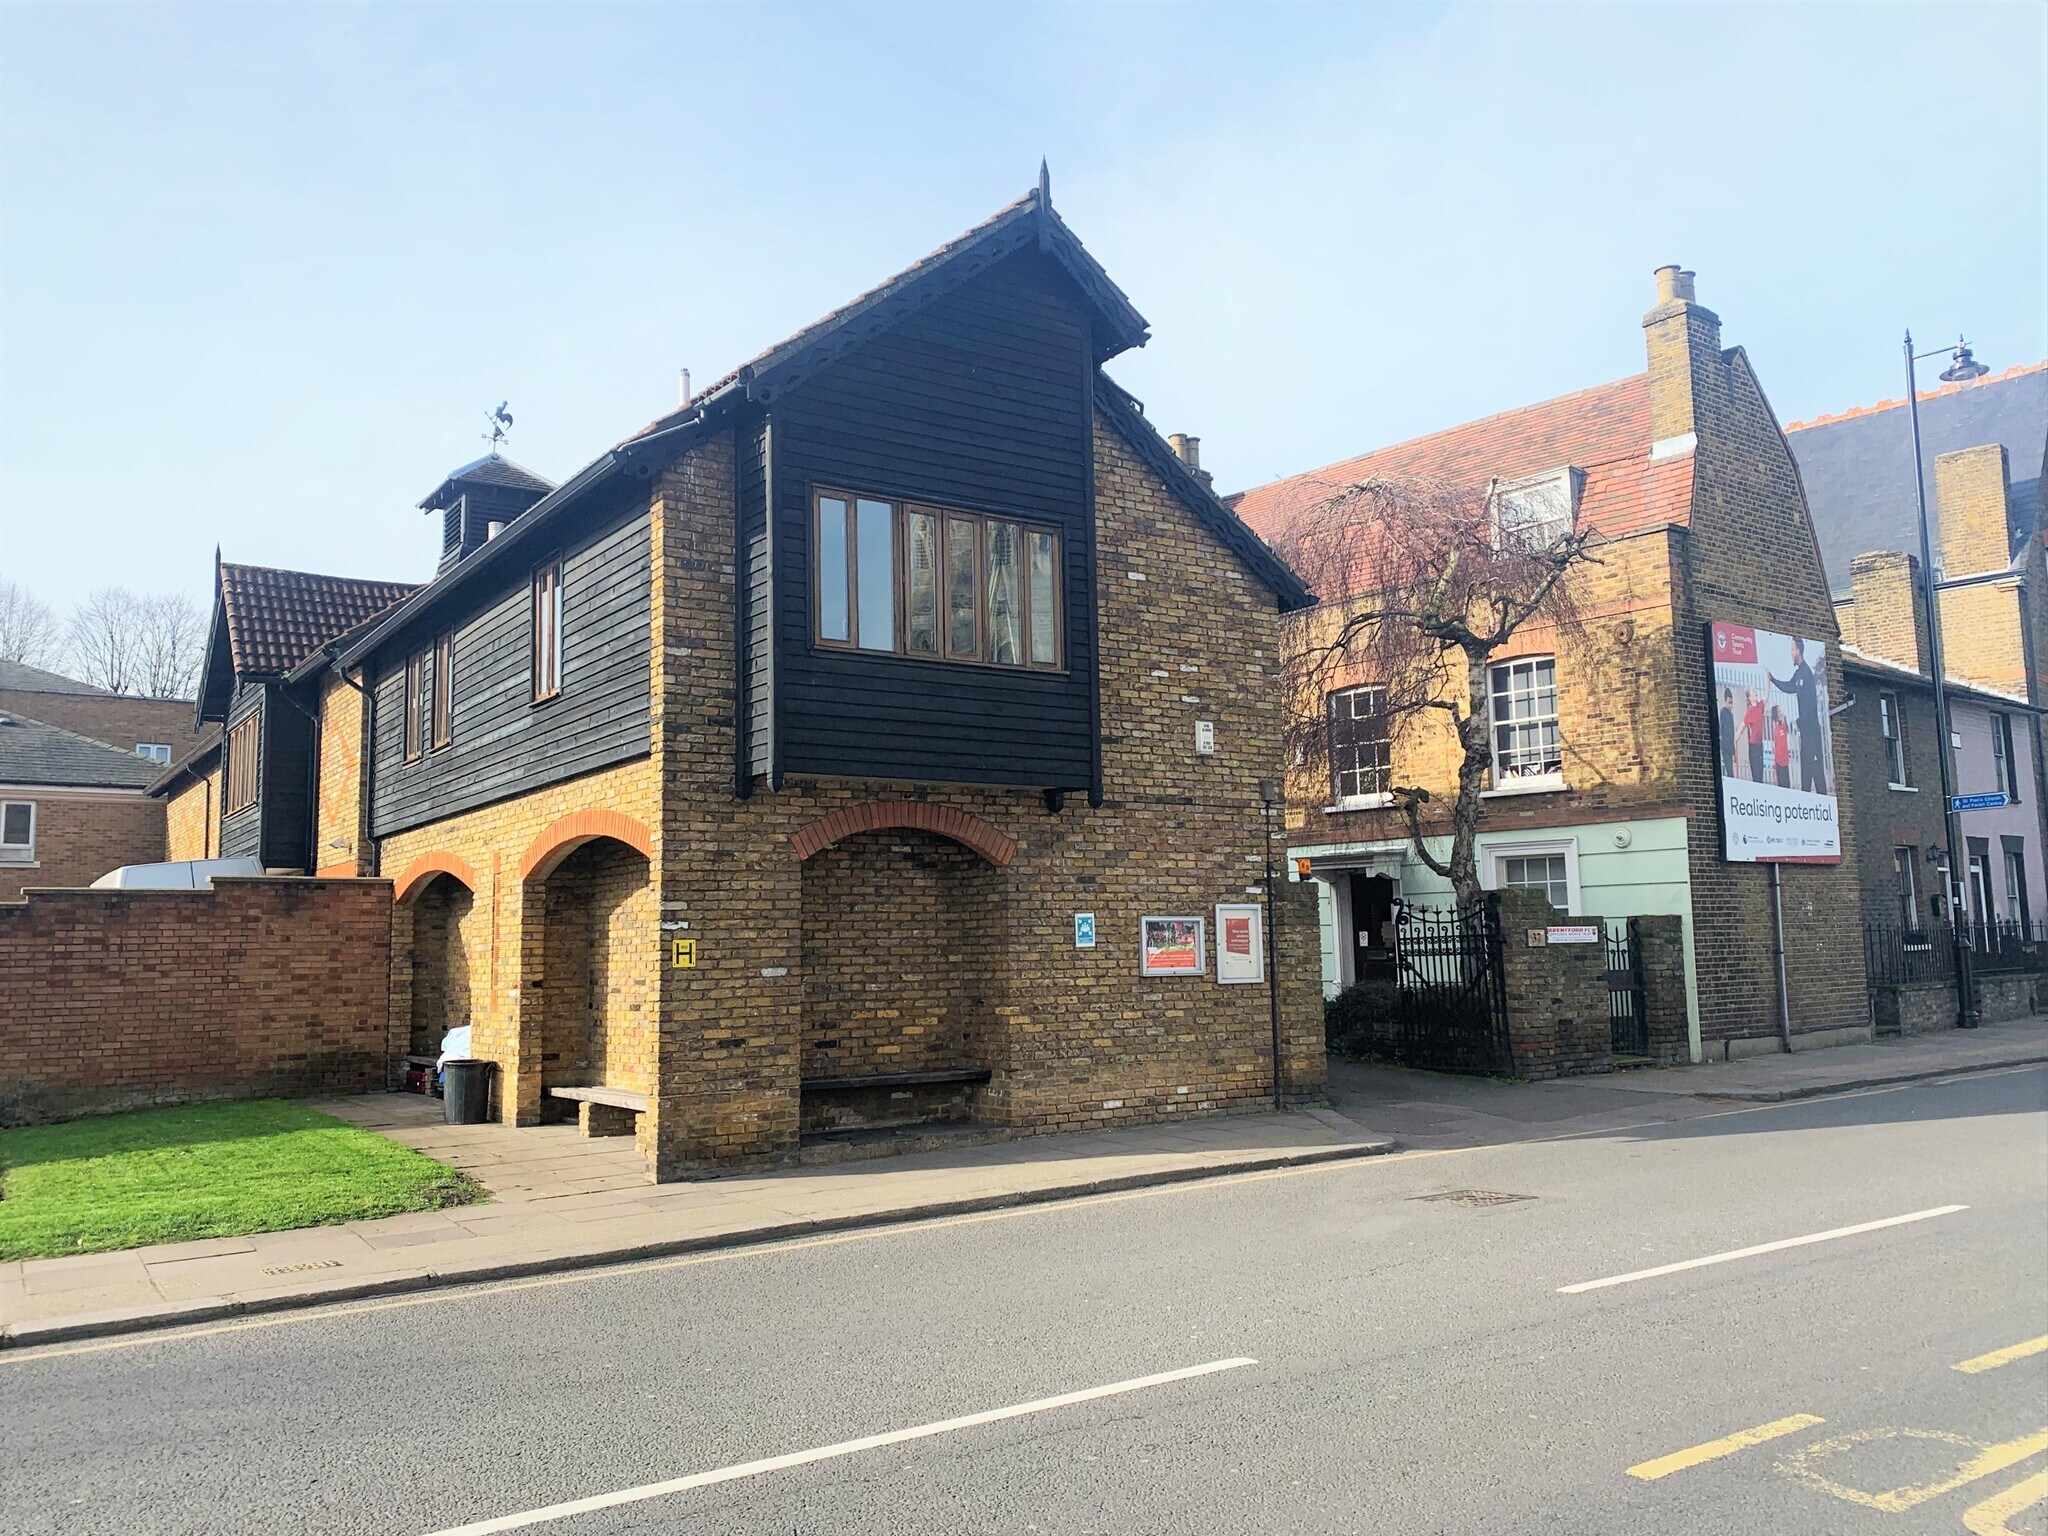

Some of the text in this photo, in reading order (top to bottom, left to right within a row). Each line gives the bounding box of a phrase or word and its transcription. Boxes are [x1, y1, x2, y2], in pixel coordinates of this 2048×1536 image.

[1731, 633, 1753, 644] Community
[1732, 640, 1744, 648] Sports
[1730, 796, 1833, 824] Realising potential
[676, 943, 692, 964] H
